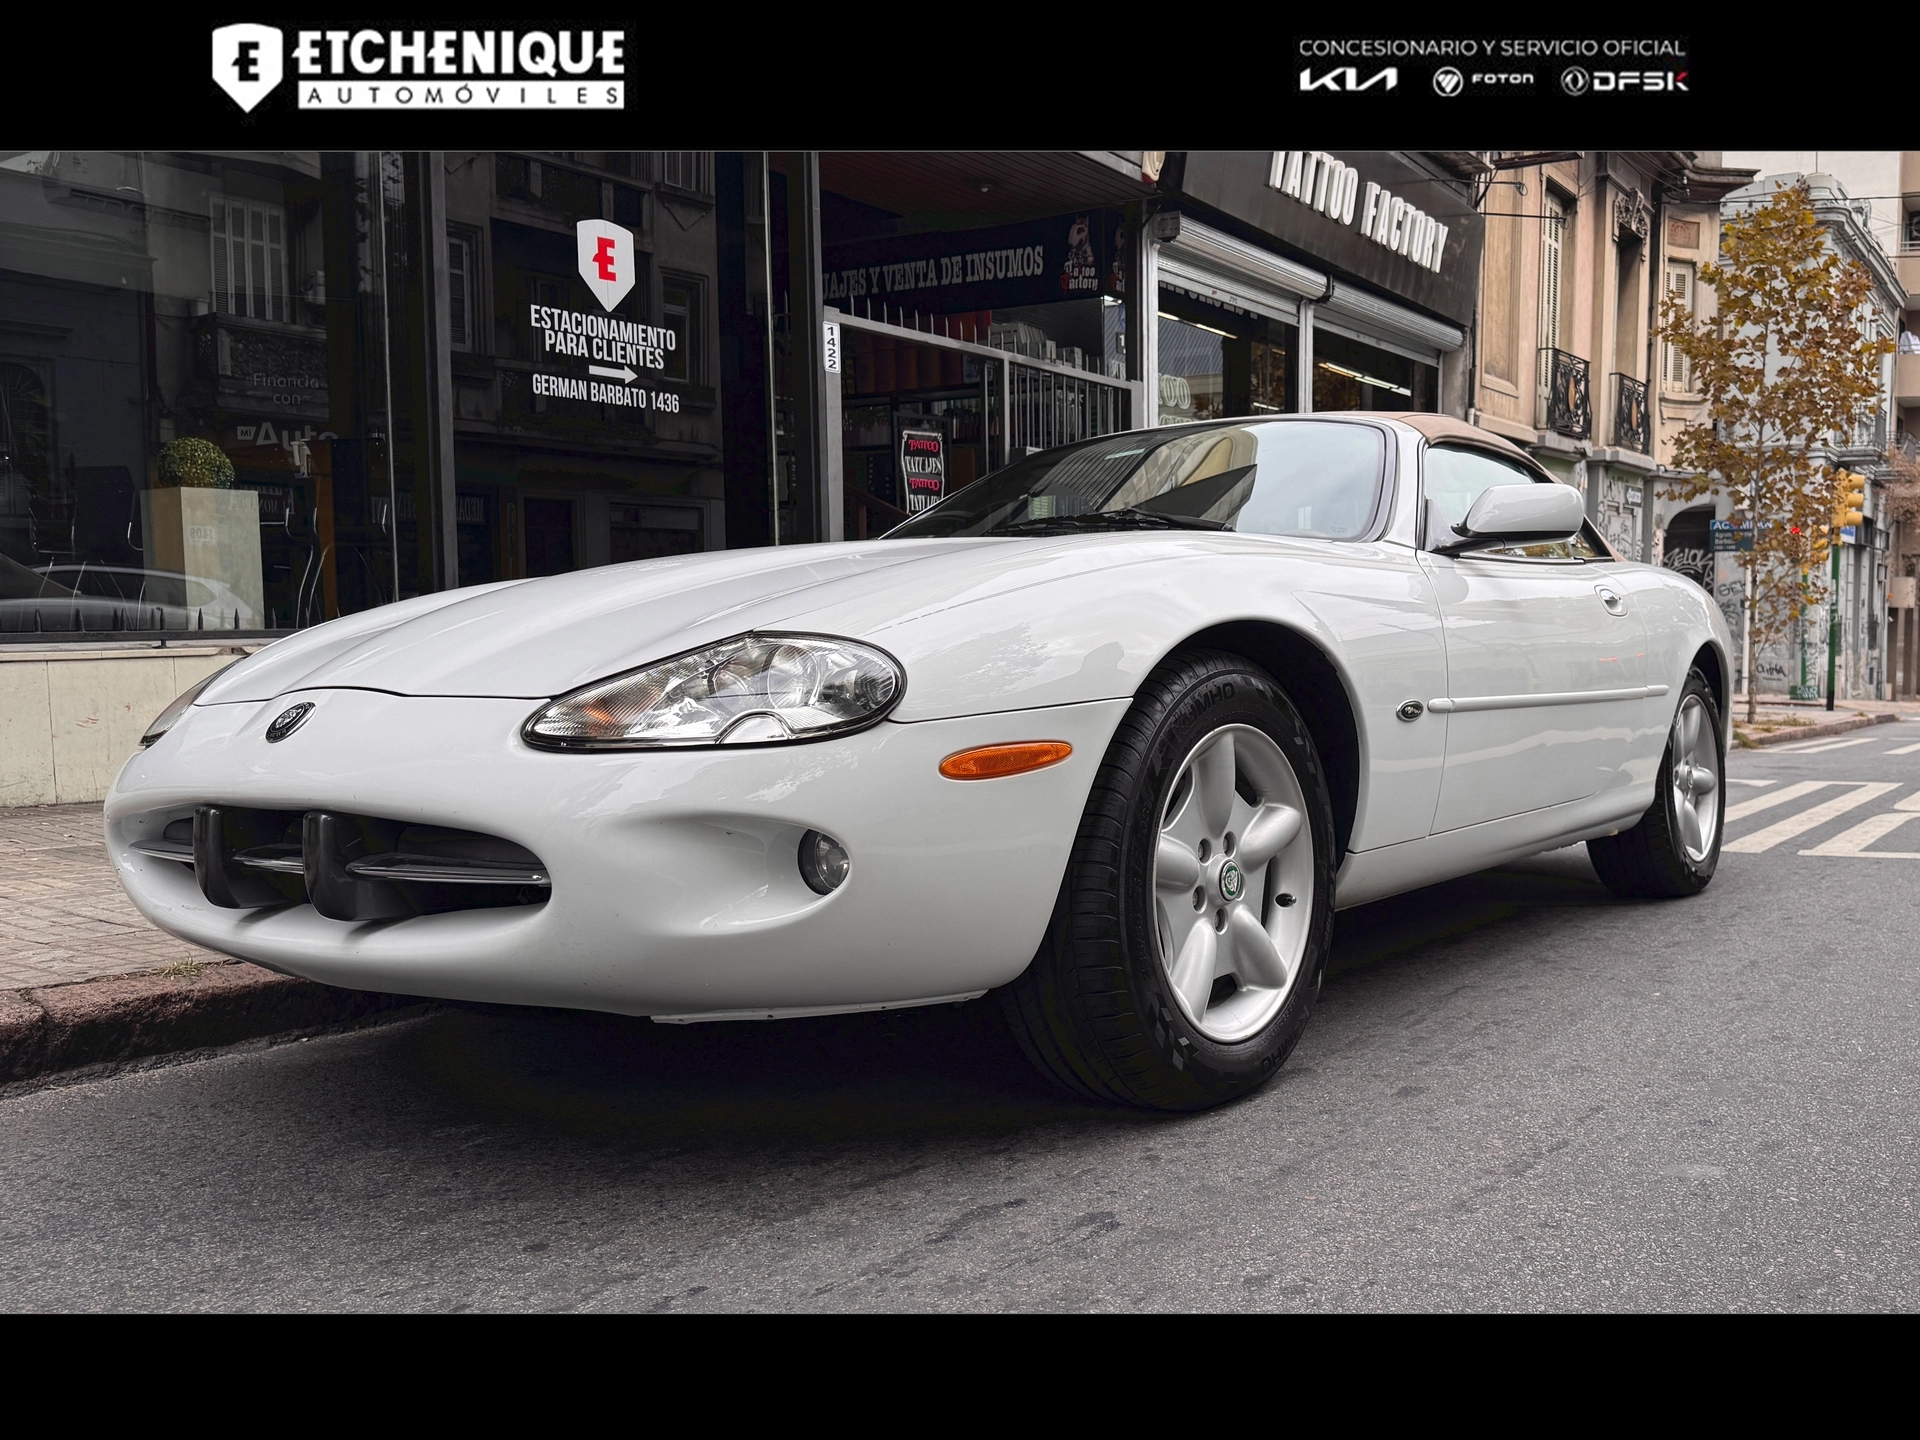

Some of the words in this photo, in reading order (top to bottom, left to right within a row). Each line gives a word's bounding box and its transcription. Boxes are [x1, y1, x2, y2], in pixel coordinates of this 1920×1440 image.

[1360, 181, 1449, 274] FACTORY
[868, 267, 881, 294] Y
[882, 258, 938, 294] VENTA
[940, 255, 963, 288] DE
[965, 245, 1045, 283] INSUMOS
[530, 304, 676, 351] ESTACIONAMIENTO
[826, 326, 838, 369] 1422
[545, 329, 589, 358] PARA
[592, 338, 664, 370] CLIENTES
[253, 372, 319, 389] Financia
[273, 393, 301, 405] con
[532, 373, 588, 401] GERMAN
[591, 382, 646, 409] BARBATO
[650, 391, 680, 414] 1436
[908, 439, 939, 453] TATTOO
[909, 478, 940, 491] TATTOO
